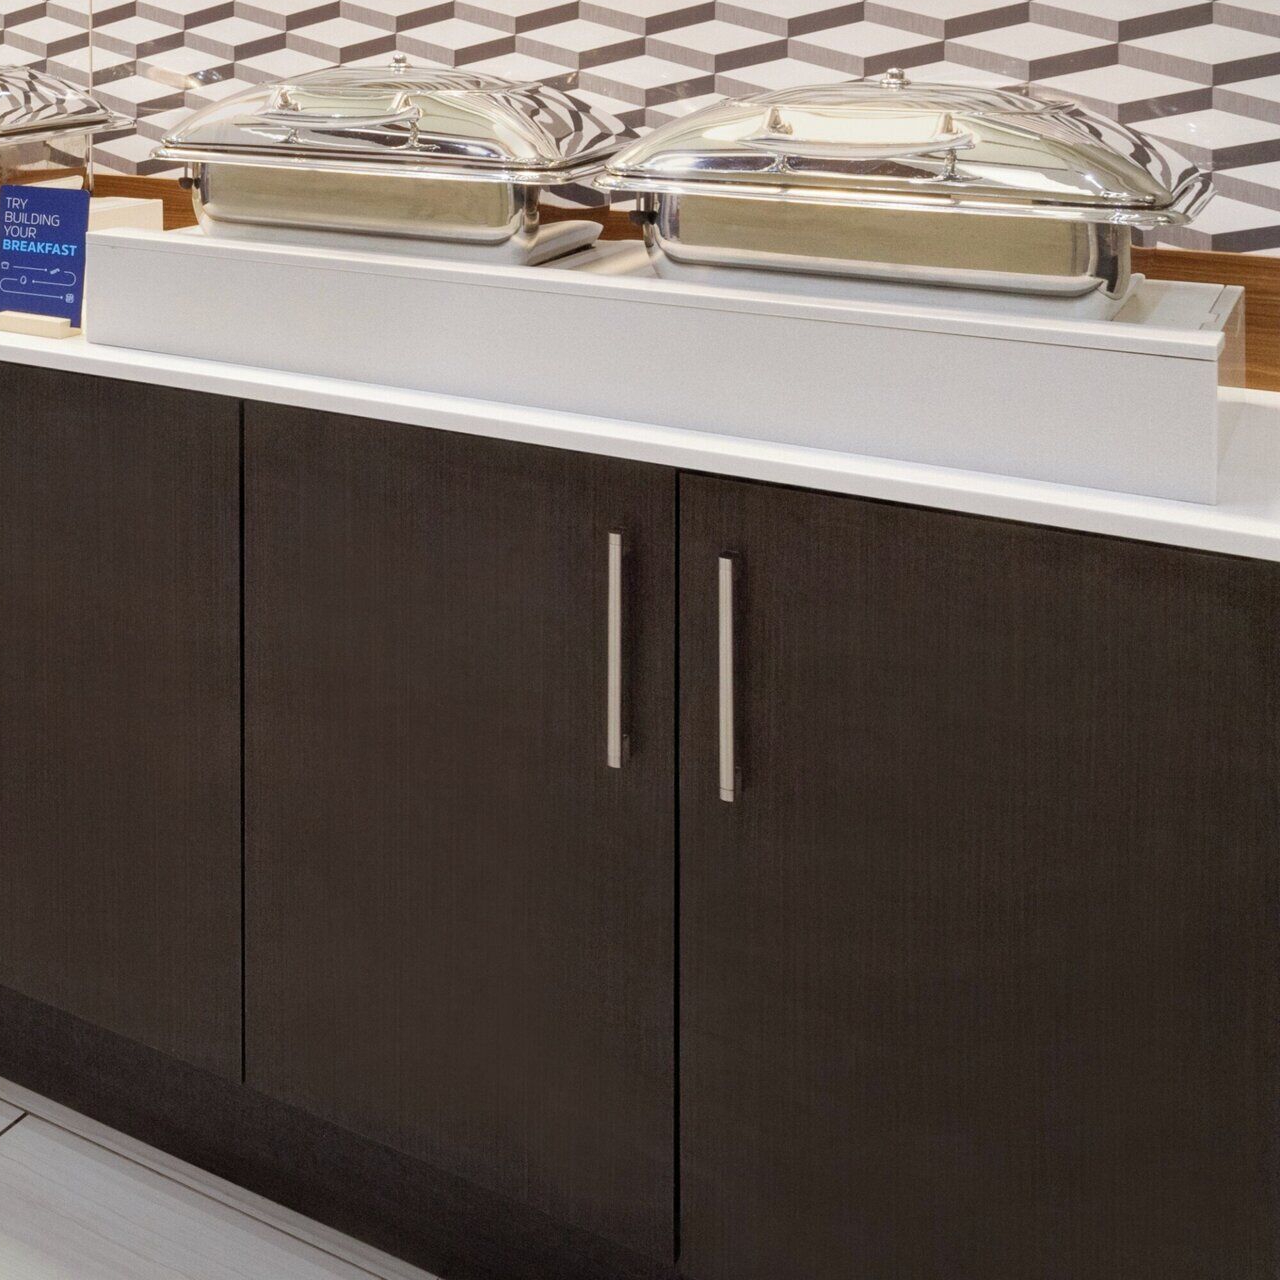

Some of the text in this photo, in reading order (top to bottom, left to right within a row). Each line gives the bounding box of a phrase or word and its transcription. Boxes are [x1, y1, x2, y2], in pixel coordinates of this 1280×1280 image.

[6, 197, 28, 209] TRY
[4, 211, 60, 227] BUILDING
[3, 225, 37, 239] YOUR
[2, 239, 78, 257] BREAKFAST
